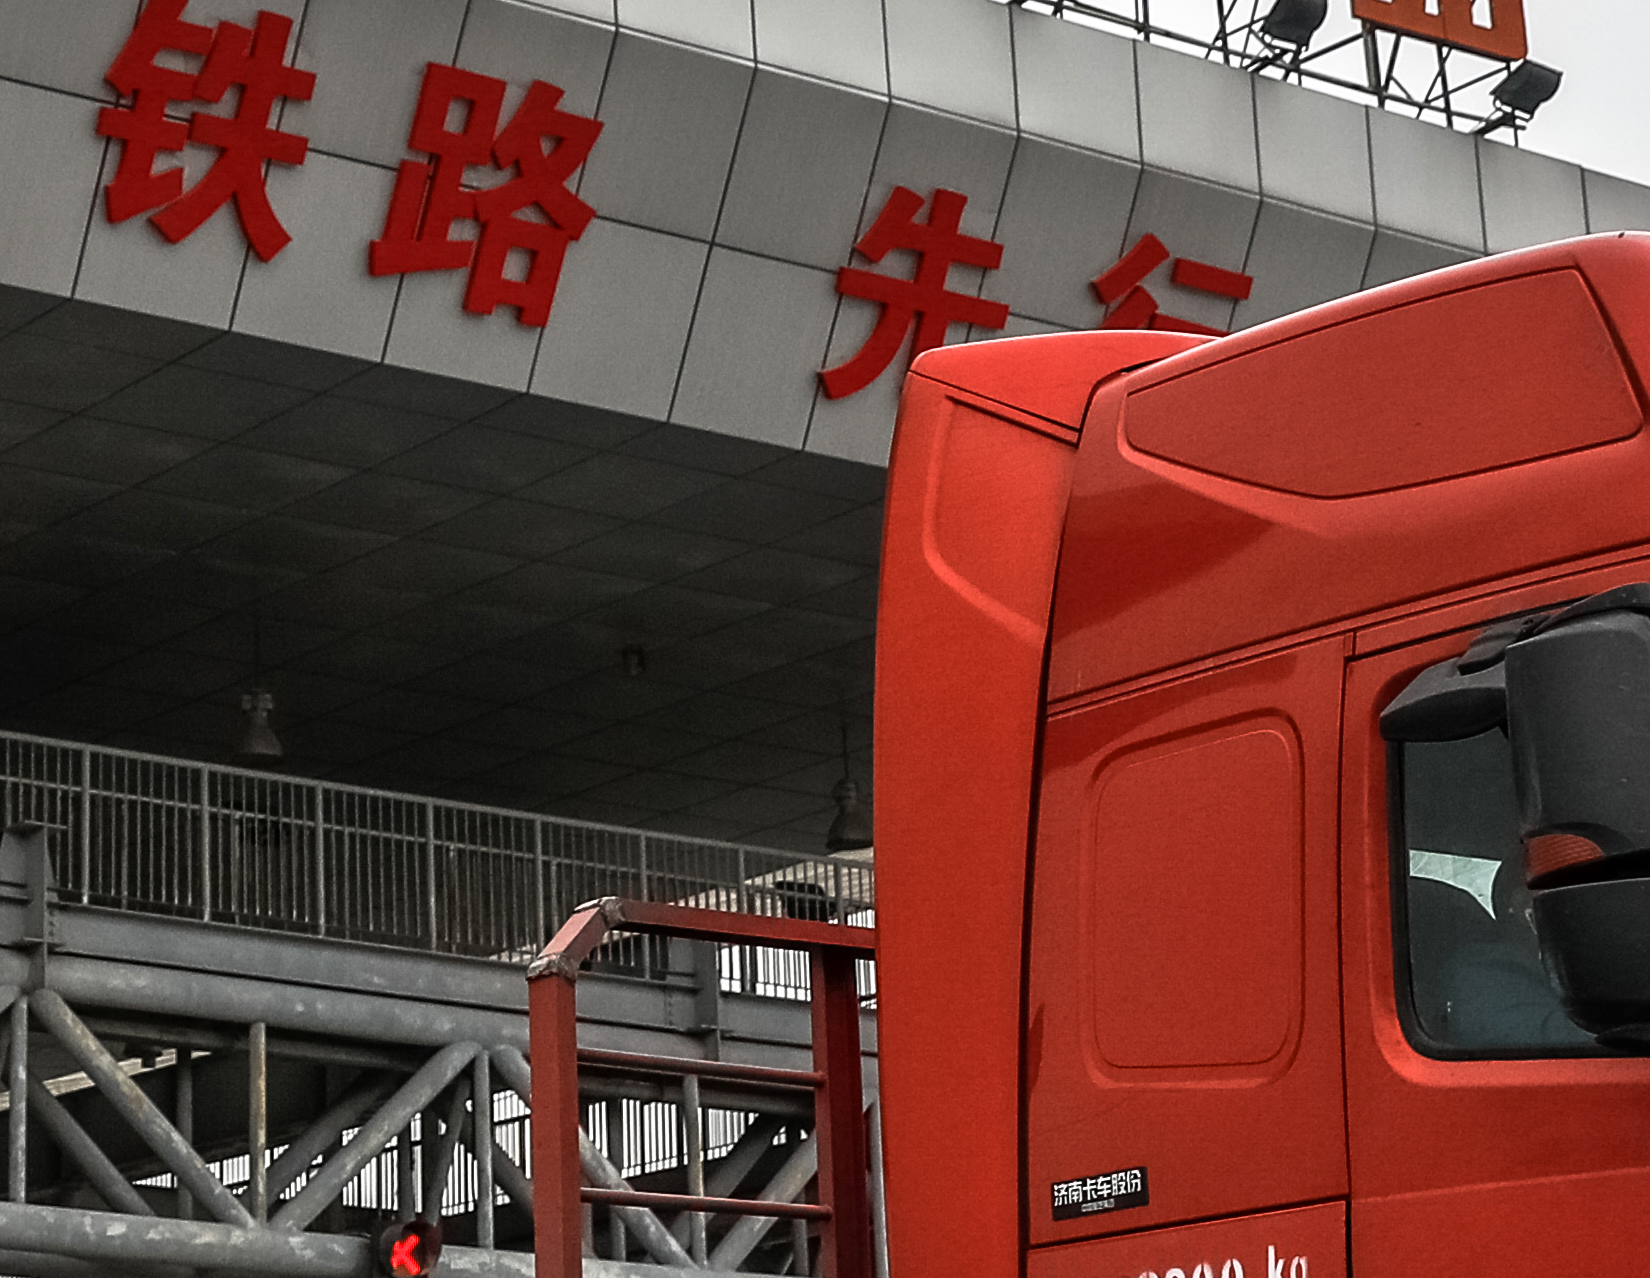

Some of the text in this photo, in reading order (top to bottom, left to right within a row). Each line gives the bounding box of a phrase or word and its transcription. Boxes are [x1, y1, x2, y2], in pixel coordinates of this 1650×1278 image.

[1053, 1169, 1142, 1207] 济南卡车股份
